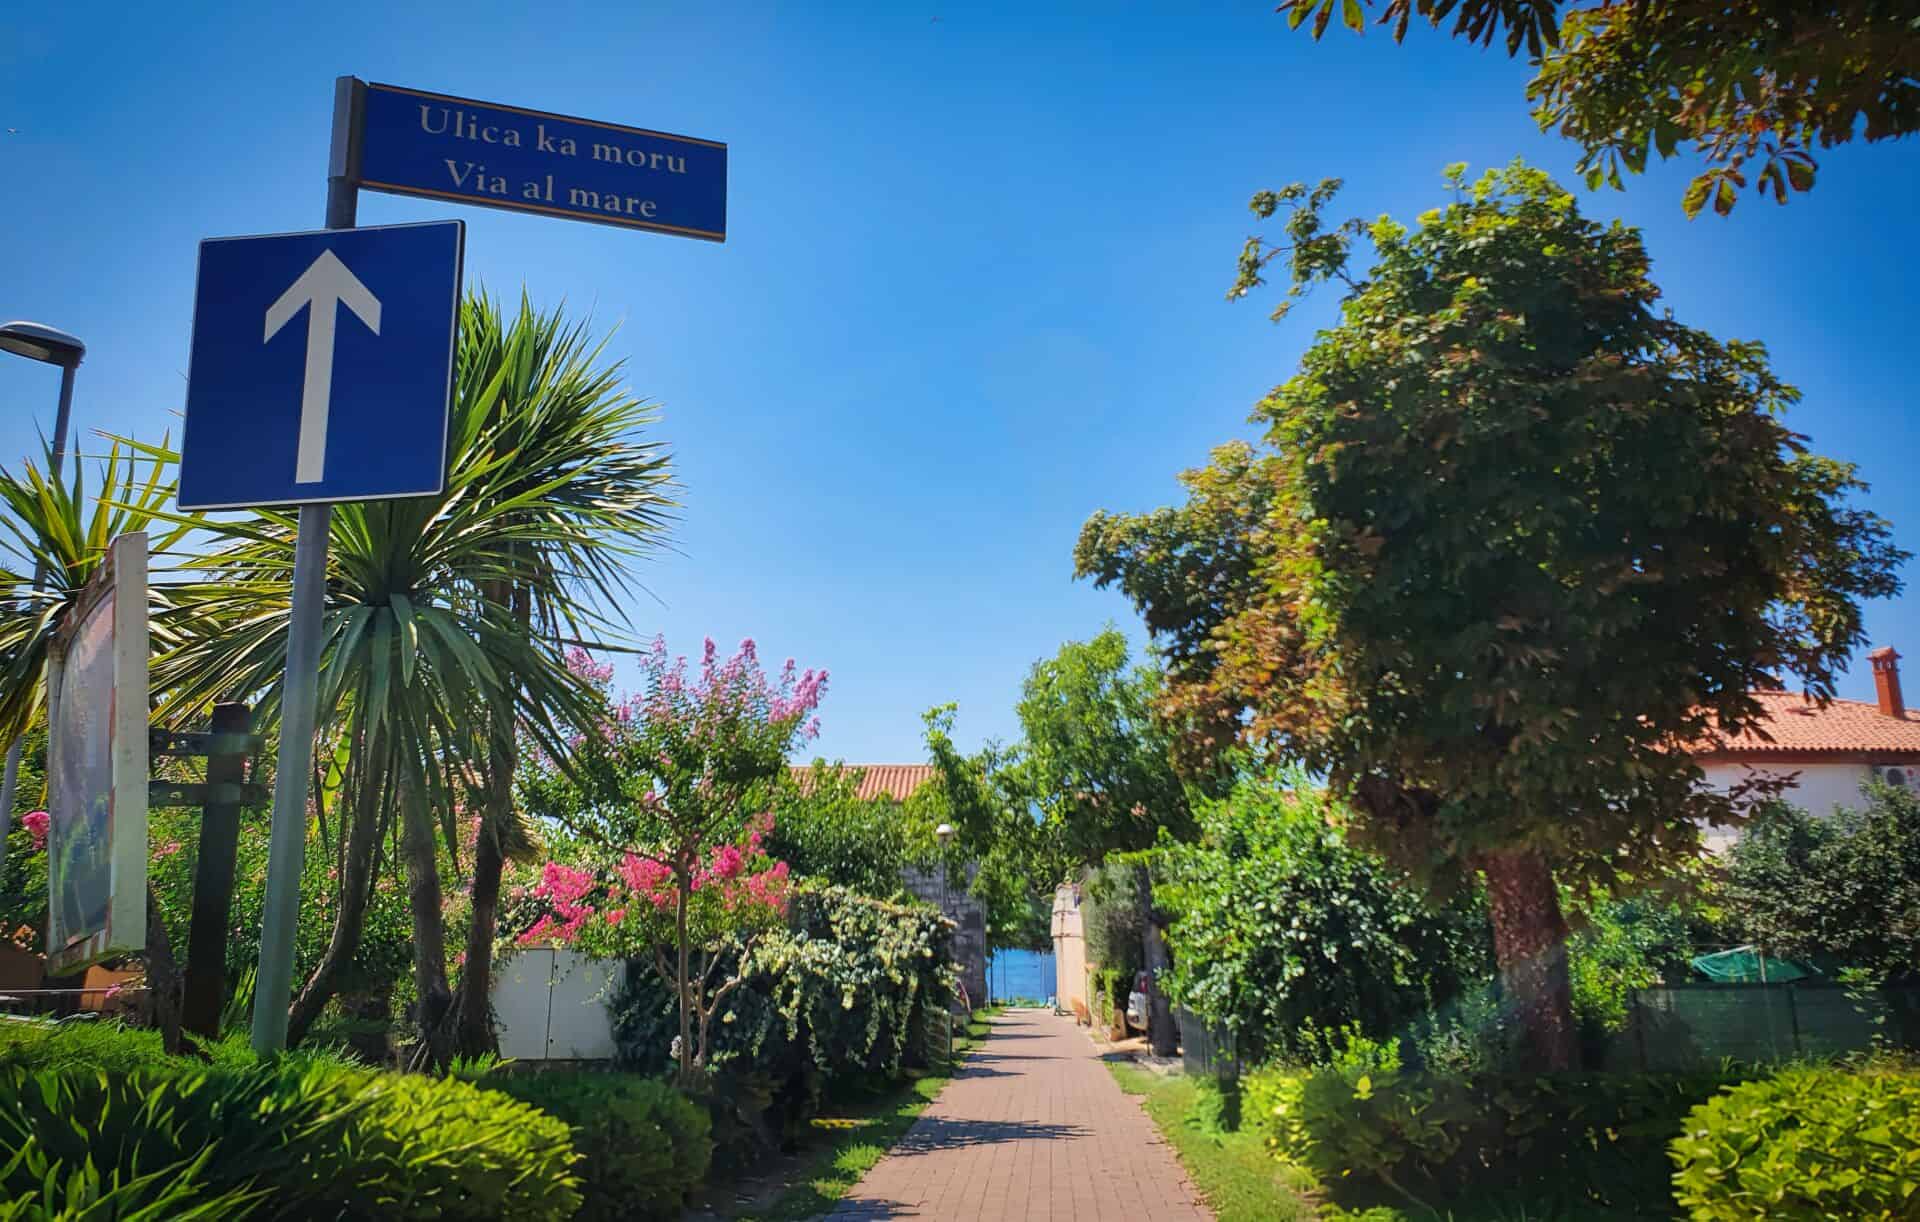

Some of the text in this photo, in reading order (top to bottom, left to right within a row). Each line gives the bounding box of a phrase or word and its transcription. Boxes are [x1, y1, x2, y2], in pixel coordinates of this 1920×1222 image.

[419, 104, 688, 175] Ulica ka moru
[445, 158, 657, 218] Via al mare
